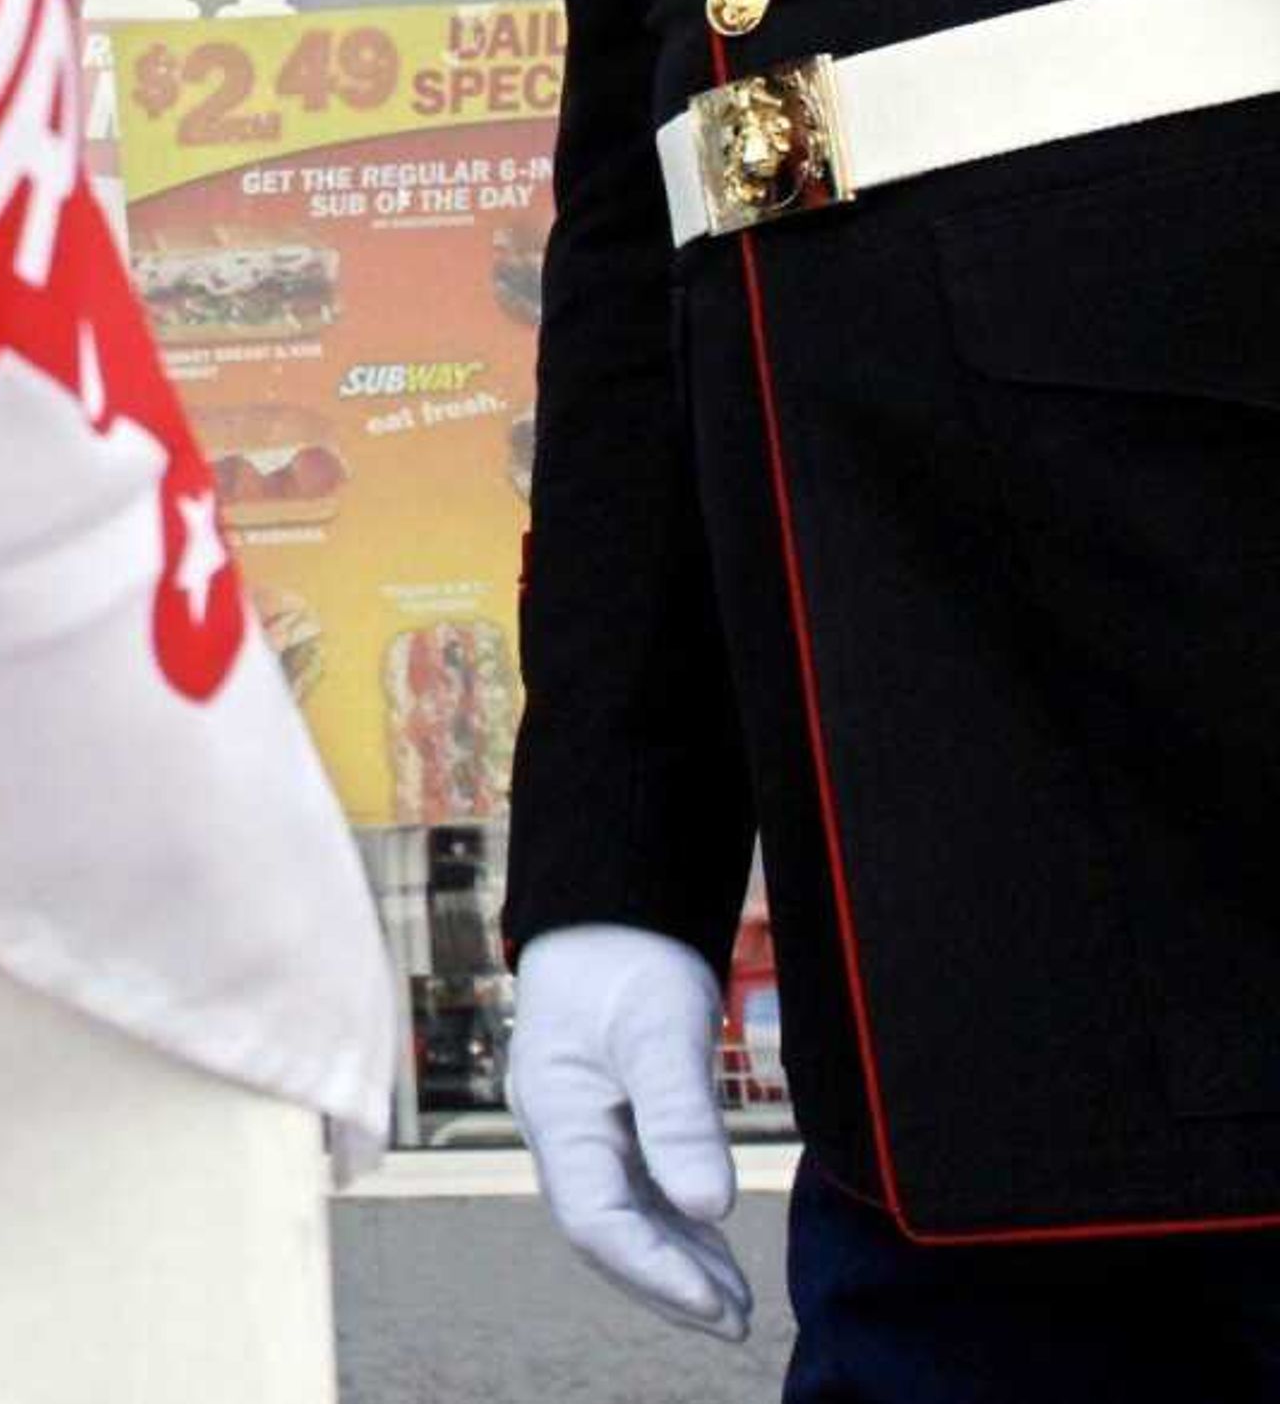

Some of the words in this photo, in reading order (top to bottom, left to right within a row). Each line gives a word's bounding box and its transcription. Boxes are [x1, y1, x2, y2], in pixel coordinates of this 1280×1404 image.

[448, 12, 565, 61] DAIL
[412, 64, 560, 115] SPEC
[242, 169, 293, 195] GET
[301, 166, 353, 191] THE
[361, 159, 491, 189] REGULAR
[500, 156, 553, 182] 6-IN
[309, 193, 368, 218] SUB
[374, 190, 412, 215] OF
[419, 187, 470, 212] THE
[477, 184, 535, 209] DAY
[341, 361, 475, 397] SUBWAY
[366, 410, 415, 435] eat
